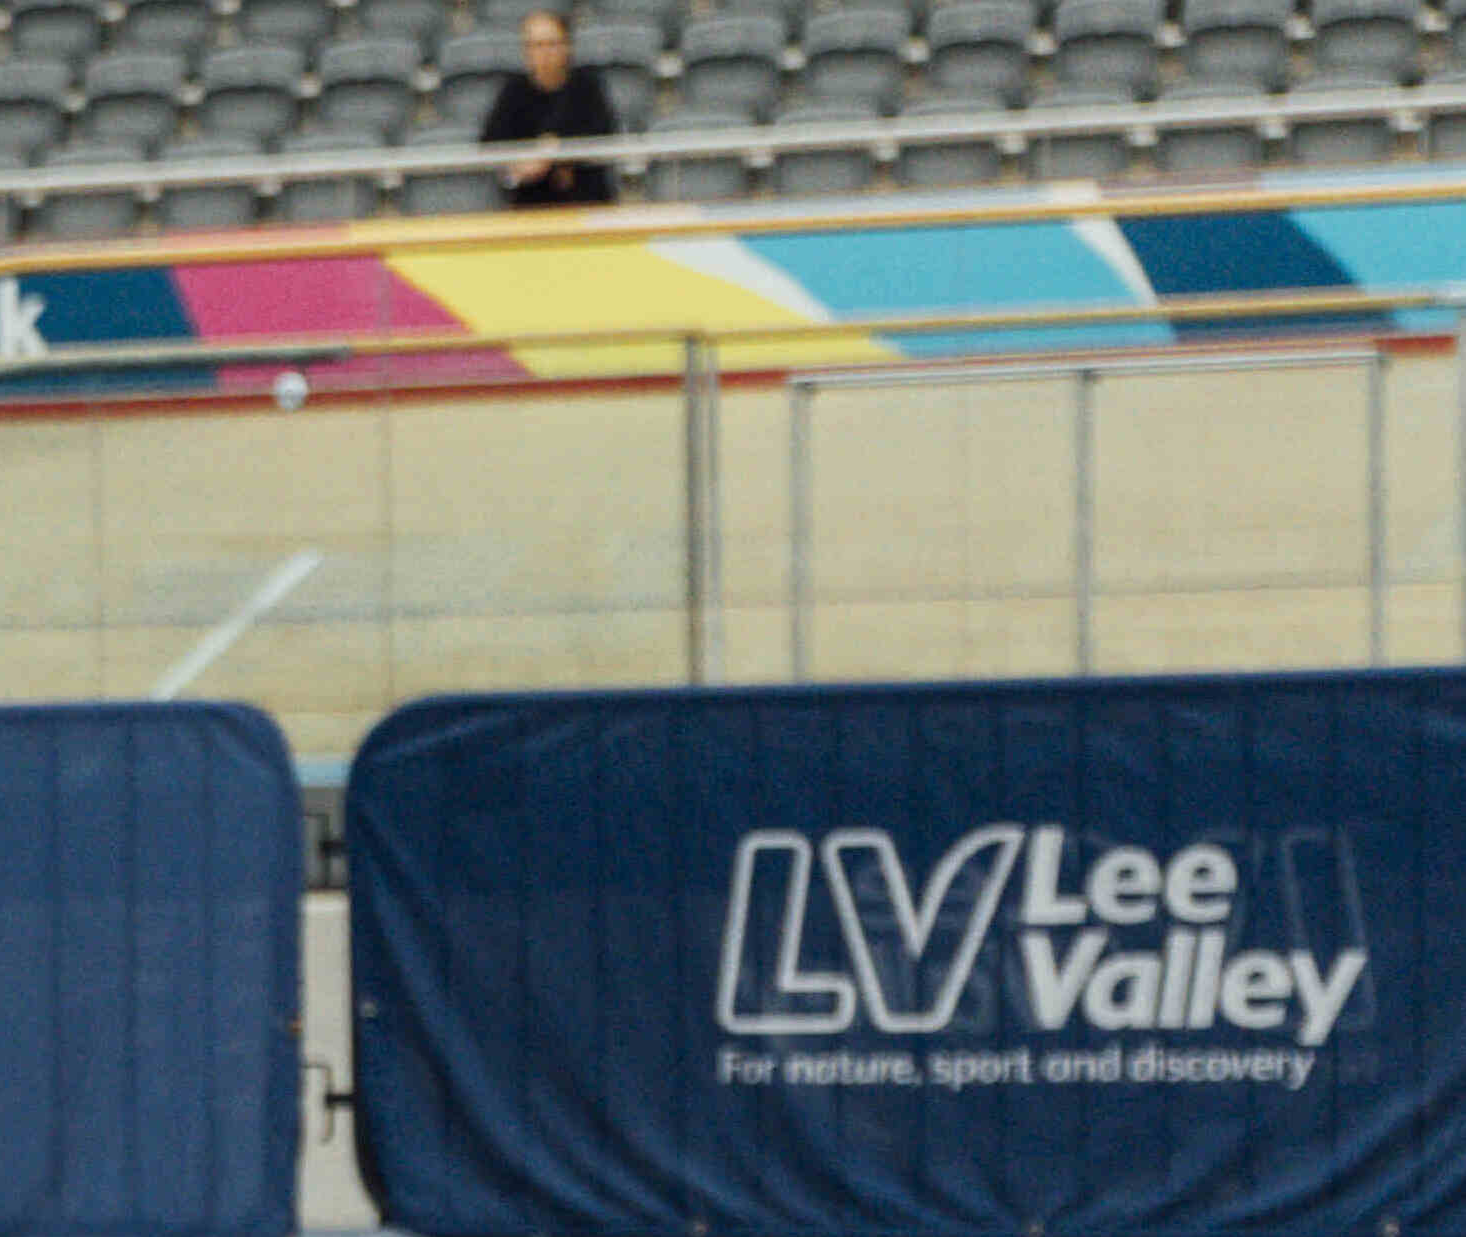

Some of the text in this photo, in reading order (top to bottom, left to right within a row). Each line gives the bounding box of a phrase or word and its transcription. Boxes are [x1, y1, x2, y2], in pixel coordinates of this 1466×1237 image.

[1020, 824, 1240, 925] Lee
[717, 825, 1024, 1035] LV
[1019, 926, 1369, 1046] Valley
[719, 1046, 1316, 1091] For nature, sport and discovery
